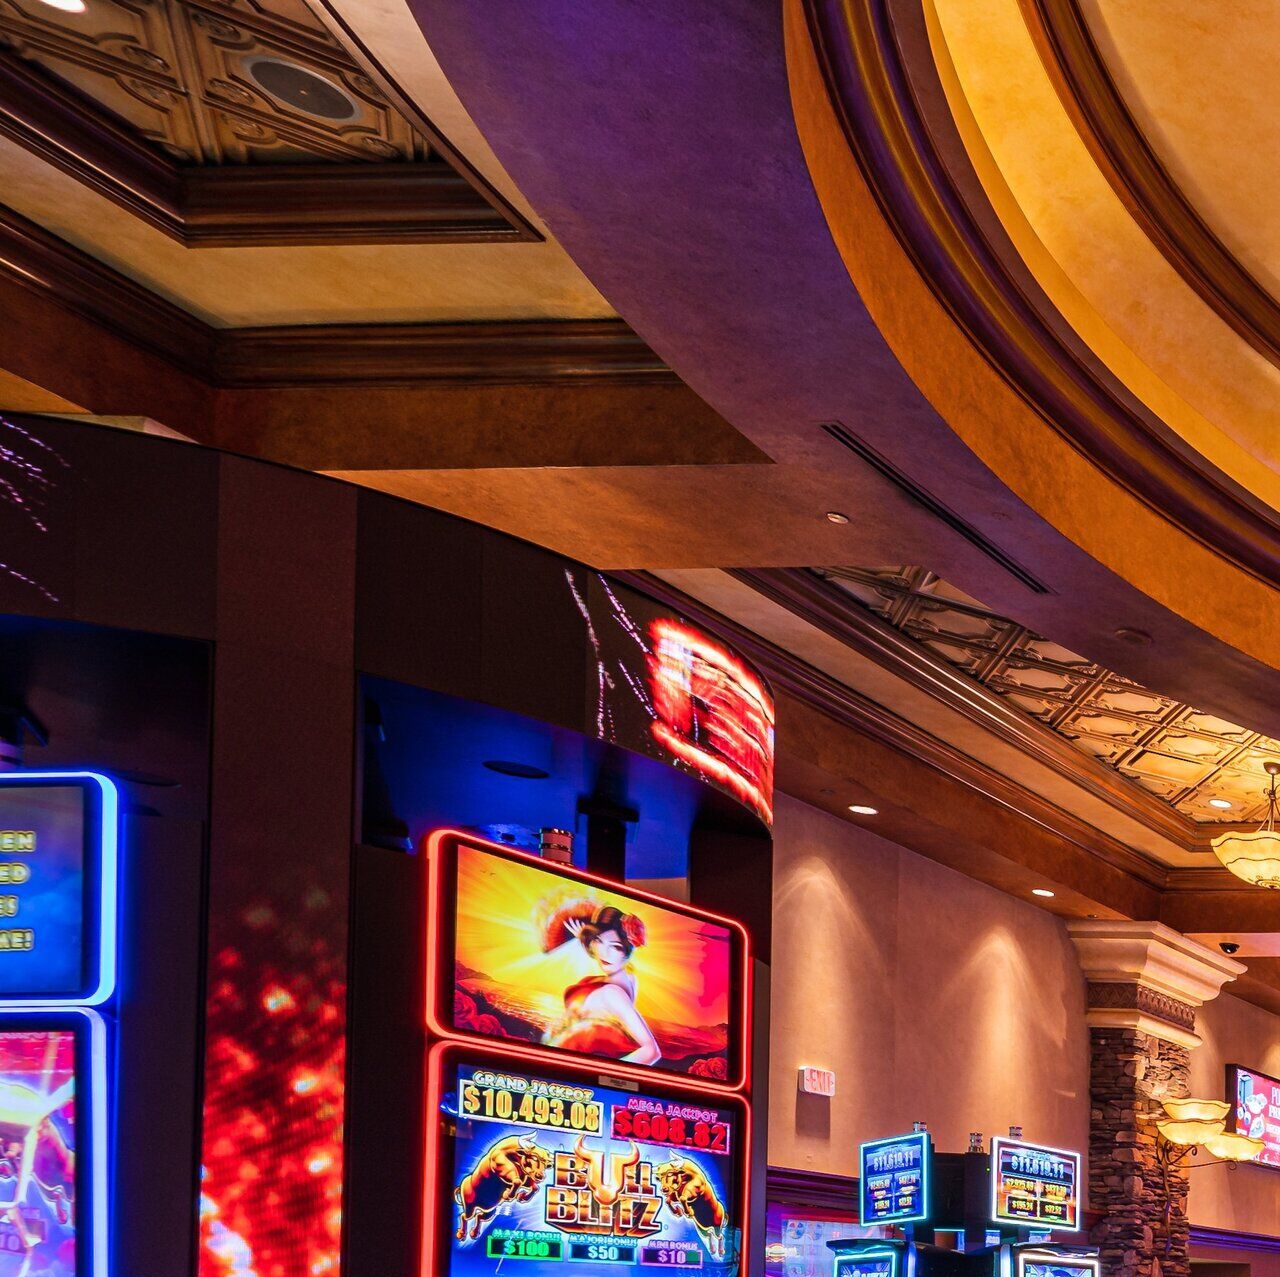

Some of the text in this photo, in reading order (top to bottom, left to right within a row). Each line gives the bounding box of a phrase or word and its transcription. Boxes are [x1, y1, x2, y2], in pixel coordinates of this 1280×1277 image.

[473, 1072, 529, 1092] GRAND
[530, 1080, 594, 1102] JACKPOT
[464, 1085, 600, 1131] $10,493.08
[628, 1099, 718, 1123] MEGA JACKPOT
[614, 1109, 726, 1149] $608.82
[546, 1186, 663, 1230] BLITZ
[504, 1240, 550, 1257] $100
[588, 1245, 619, 1260] $50
[658, 1250, 686, 1264] $10
